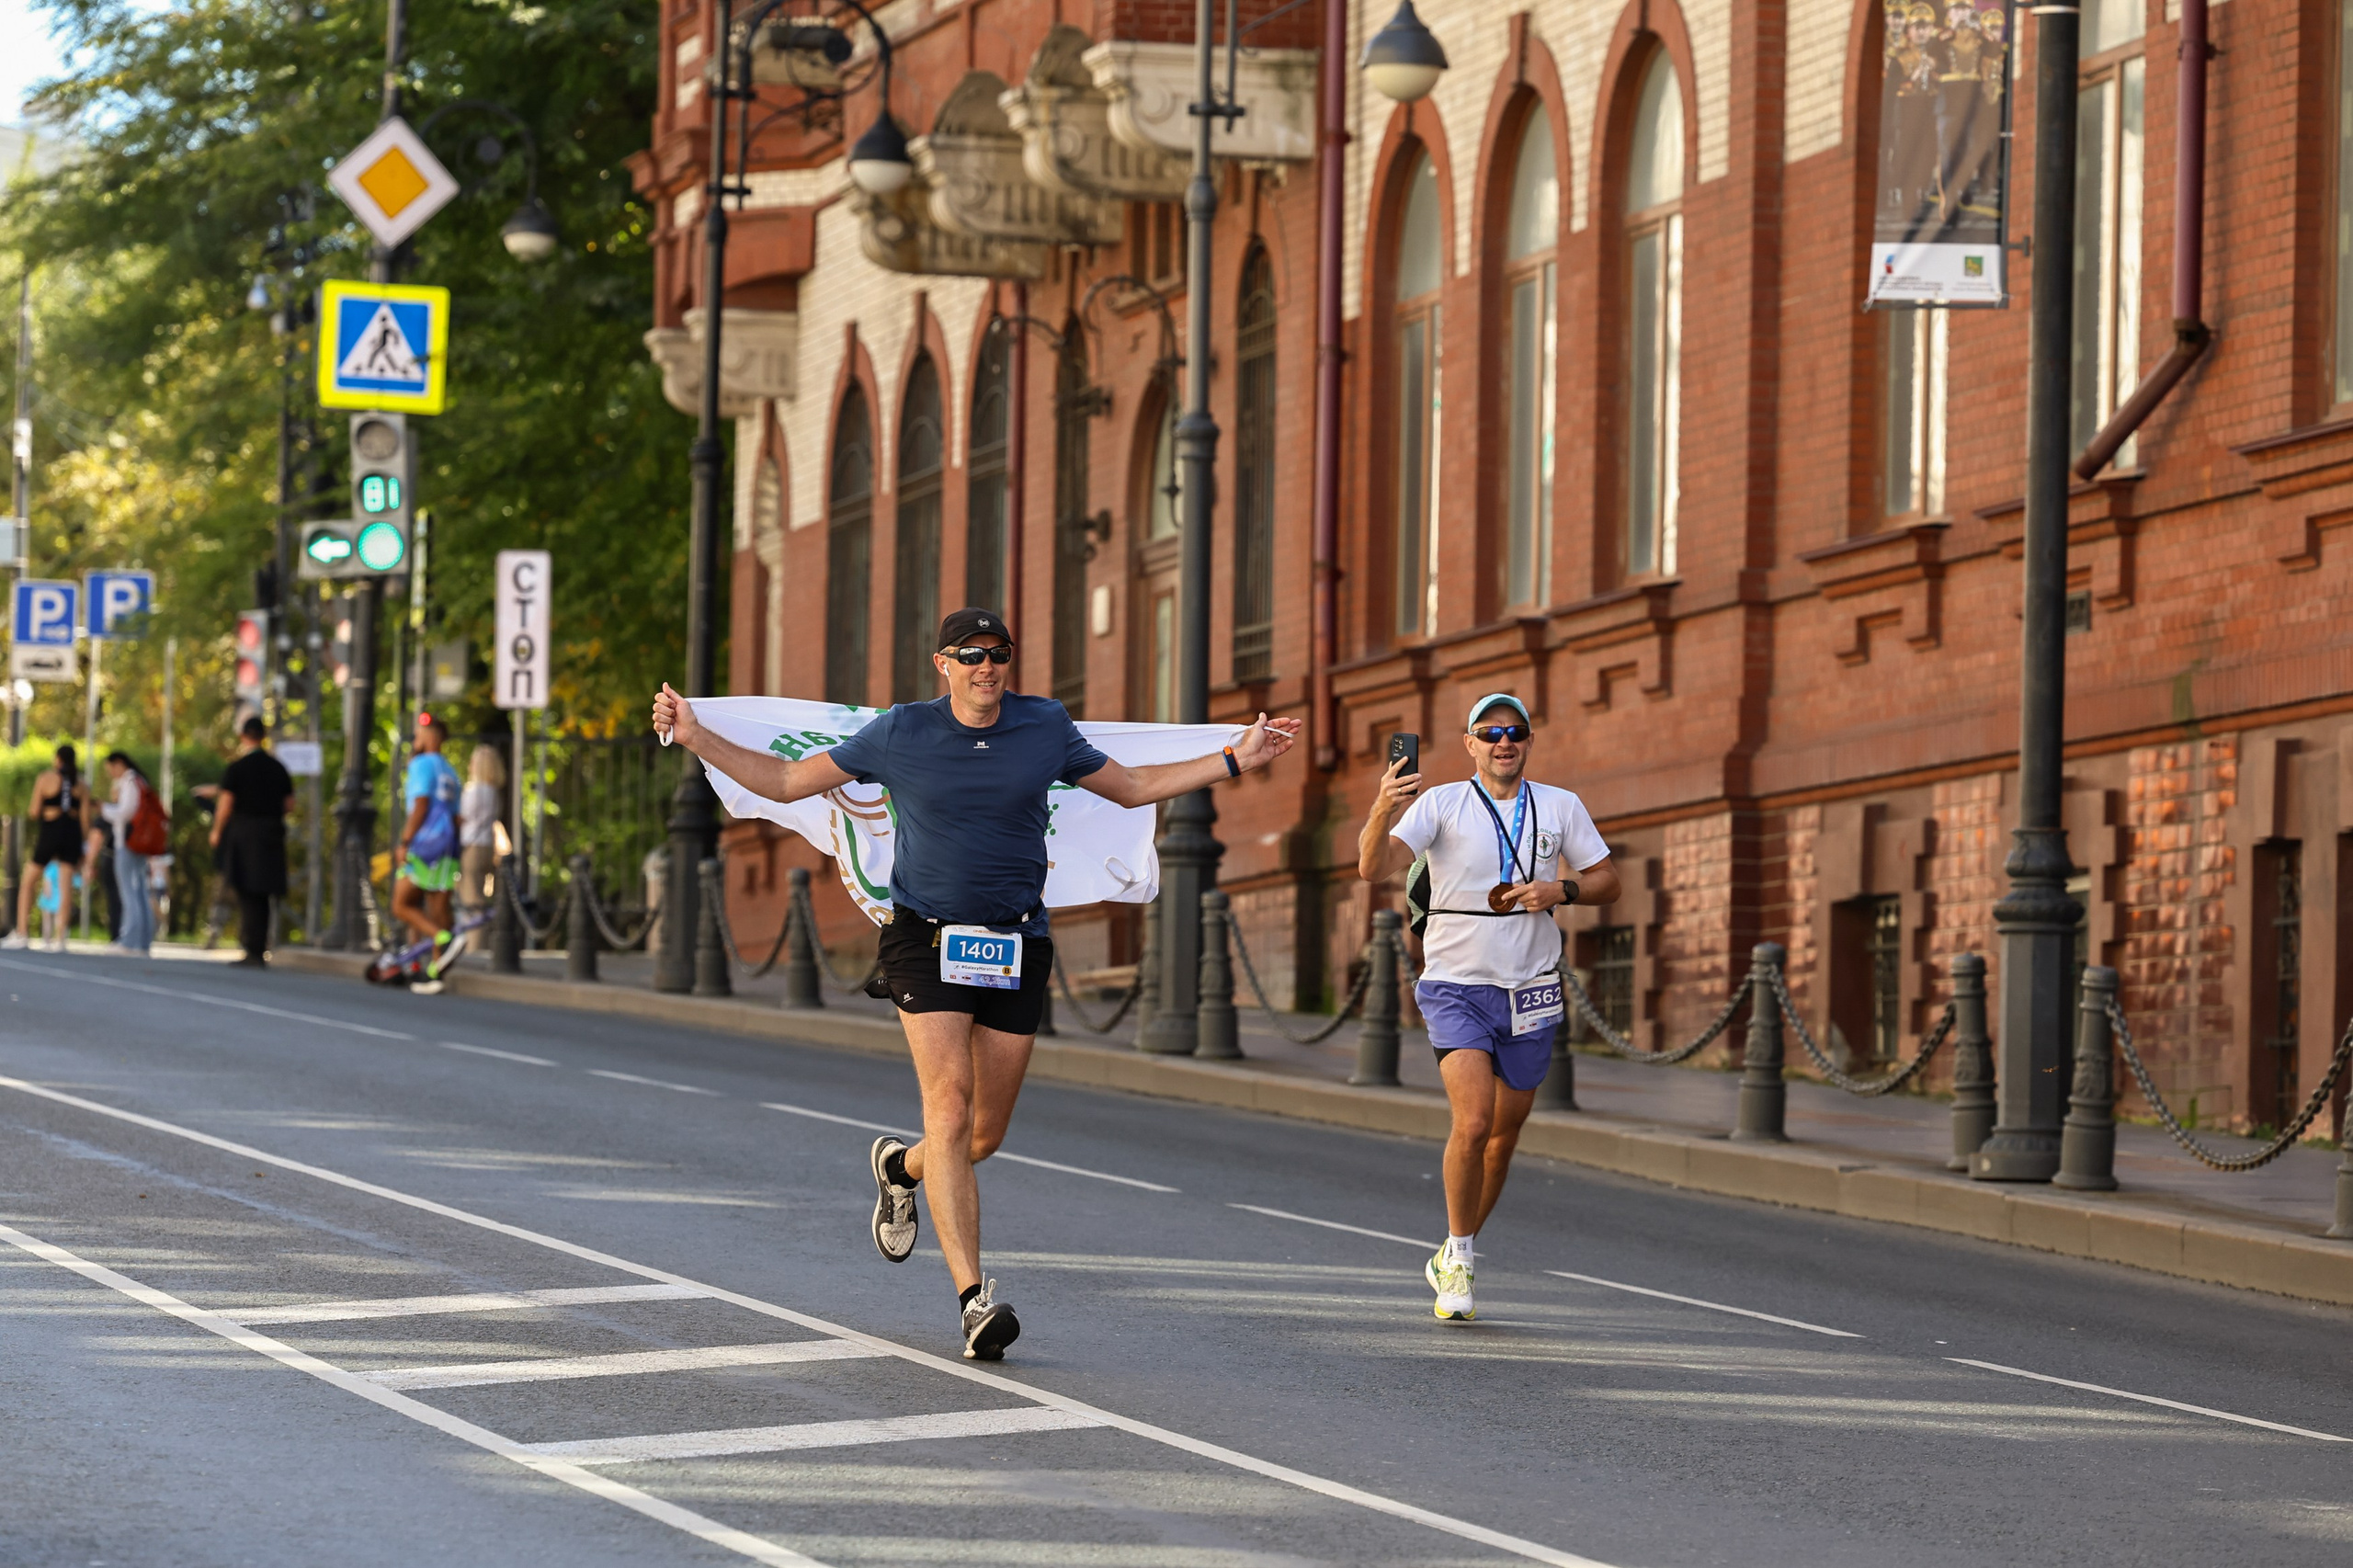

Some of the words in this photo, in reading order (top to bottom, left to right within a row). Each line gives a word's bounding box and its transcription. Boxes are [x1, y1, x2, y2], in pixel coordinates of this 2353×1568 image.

[29, 588, 67, 642] P
[512, 562, 535, 698] СТОП
[959, 940, 1003, 960] 1401
[1521, 986, 1562, 1009] 2362
